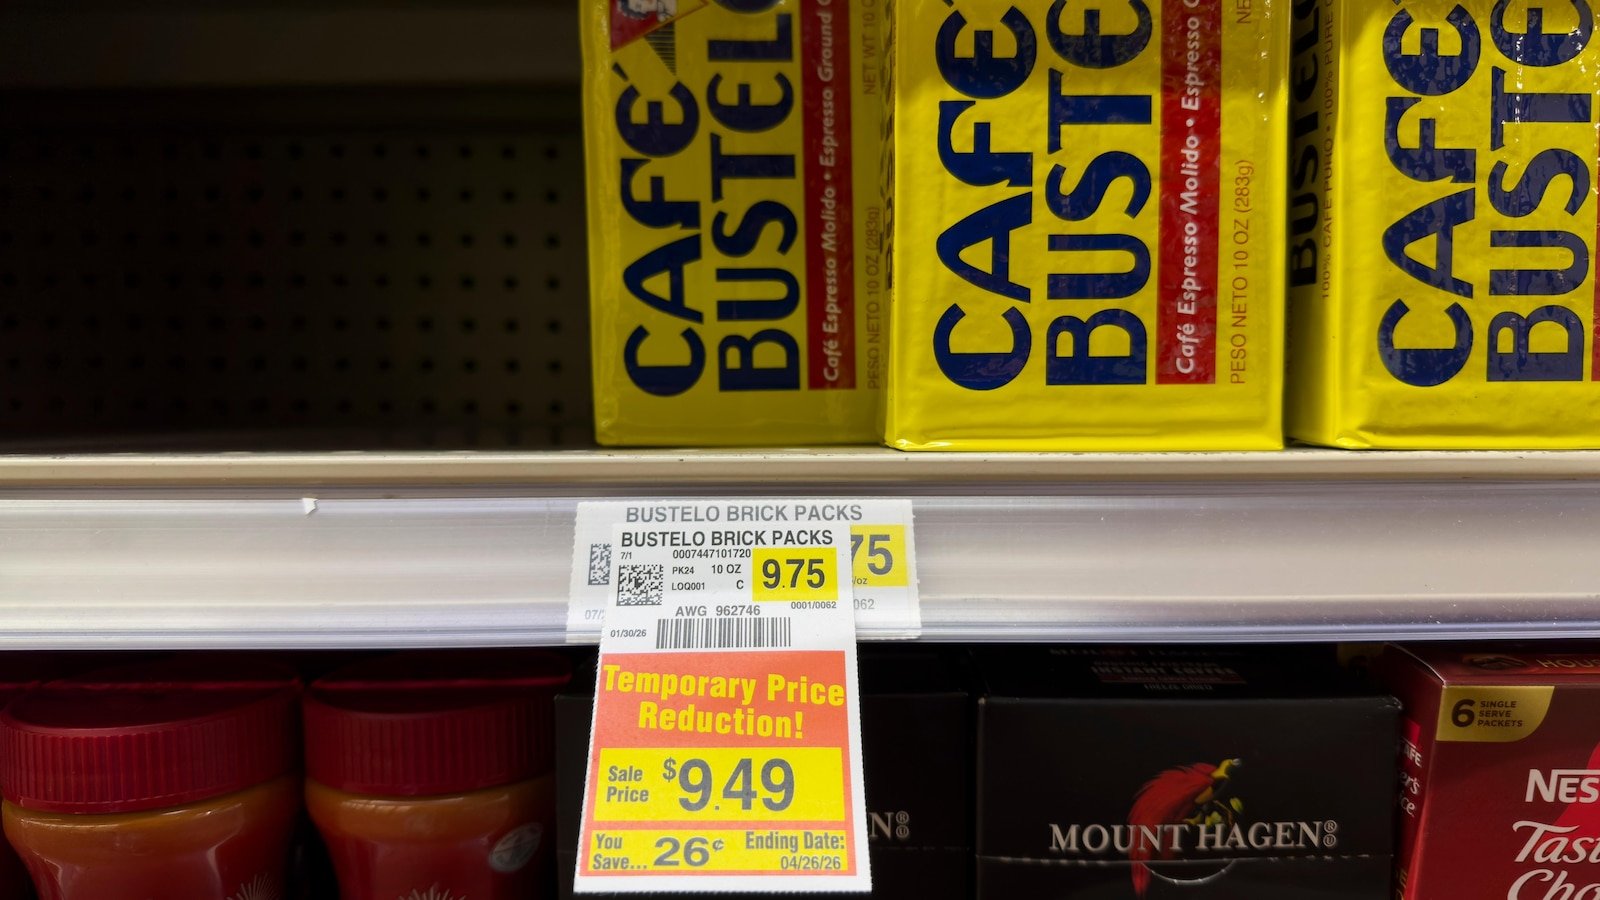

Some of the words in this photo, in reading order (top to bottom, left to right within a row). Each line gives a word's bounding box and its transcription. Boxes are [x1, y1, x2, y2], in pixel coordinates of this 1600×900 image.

[862, 12, 876, 28] 10
[817, 12, 834, 83] Ground
[862, 34, 876, 59] WT
[1323, 13, 1335, 64] PURE
[862, 62, 877, 95] NET
[1181, 17, 1205, 110] Espresso
[1323, 71, 1334, 118] 100%
[818, 89, 839, 167] Espresso
[1178, 134, 1200, 214] Molido
[1322, 137, 1334, 192] PURO
[707, 0, 801, 391] BUSTEL
[1233, 160, 1254, 213] (283g)
[612, 62, 706, 397] CAFÉ
[820, 186, 838, 252] Molido
[1233, 219, 1249, 245] OZ
[866, 255, 880, 276] OZ
[1176, 221, 1202, 315] Espresso
[1232, 251, 1248, 270] 10
[866, 280, 880, 297] 10
[1321, 254, 1332, 300] 100%
[822, 257, 841, 333] Espresso
[1231, 277, 1248, 328] NETO
[866, 302, 880, 344] NETO
[821, 340, 841, 382] Café
[1175, 323, 1200, 374] Café
[1230, 333, 1247, 384] PESO
[866, 348, 881, 390] PESO
[625, 505, 720, 523] BUSTELO
[727, 504, 788, 522] BRICK
[795, 504, 863, 521] PACKS
[621, 531, 705, 547] BUSTELO
[711, 530, 767, 546] BRICK
[772, 529, 833, 546] PACKS
[620, 552, 632, 560] 7/1
[672, 548, 752, 559] 0007447101720
[672, 566, 695, 575] PK24
[711, 564, 724, 574] 10
[726, 563, 742, 574] OZ
[671, 582, 705, 591] LOQ001
[736, 579, 745, 590] C
[762, 558, 825, 589] 9.75
[675, 605, 708, 617] AWG
[715, 605, 761, 616] 962746
[790, 601, 837, 610] 0001/0062
[610, 629, 647, 638] 01/30/26
[603, 664, 757, 705] Temporary
[767, 673, 845, 707] Price
[1451, 699, 1476, 728] 6
[1478, 710, 1512, 718] SERVE
[1480, 700, 1517, 708] SINGLE
[638, 701, 804, 739] Reduction!
[1477, 719, 1523, 728] PACKETS
[608, 765, 643, 782] Sale
[662, 756, 795, 813] $9.49
[1525, 768, 1600, 803] NES
[606, 786, 649, 803] Price
[595, 833, 623, 850] You
[745, 831, 800, 854] Ending
[803, 832, 846, 850] Date:
[1048, 822, 1190, 851] MOUNT
[1195, 821, 1323, 850] HAGEN
[592, 853, 648, 870] Save...
[653, 837, 725, 867] 26¢
[780, 855, 842, 870] 04/26/26
